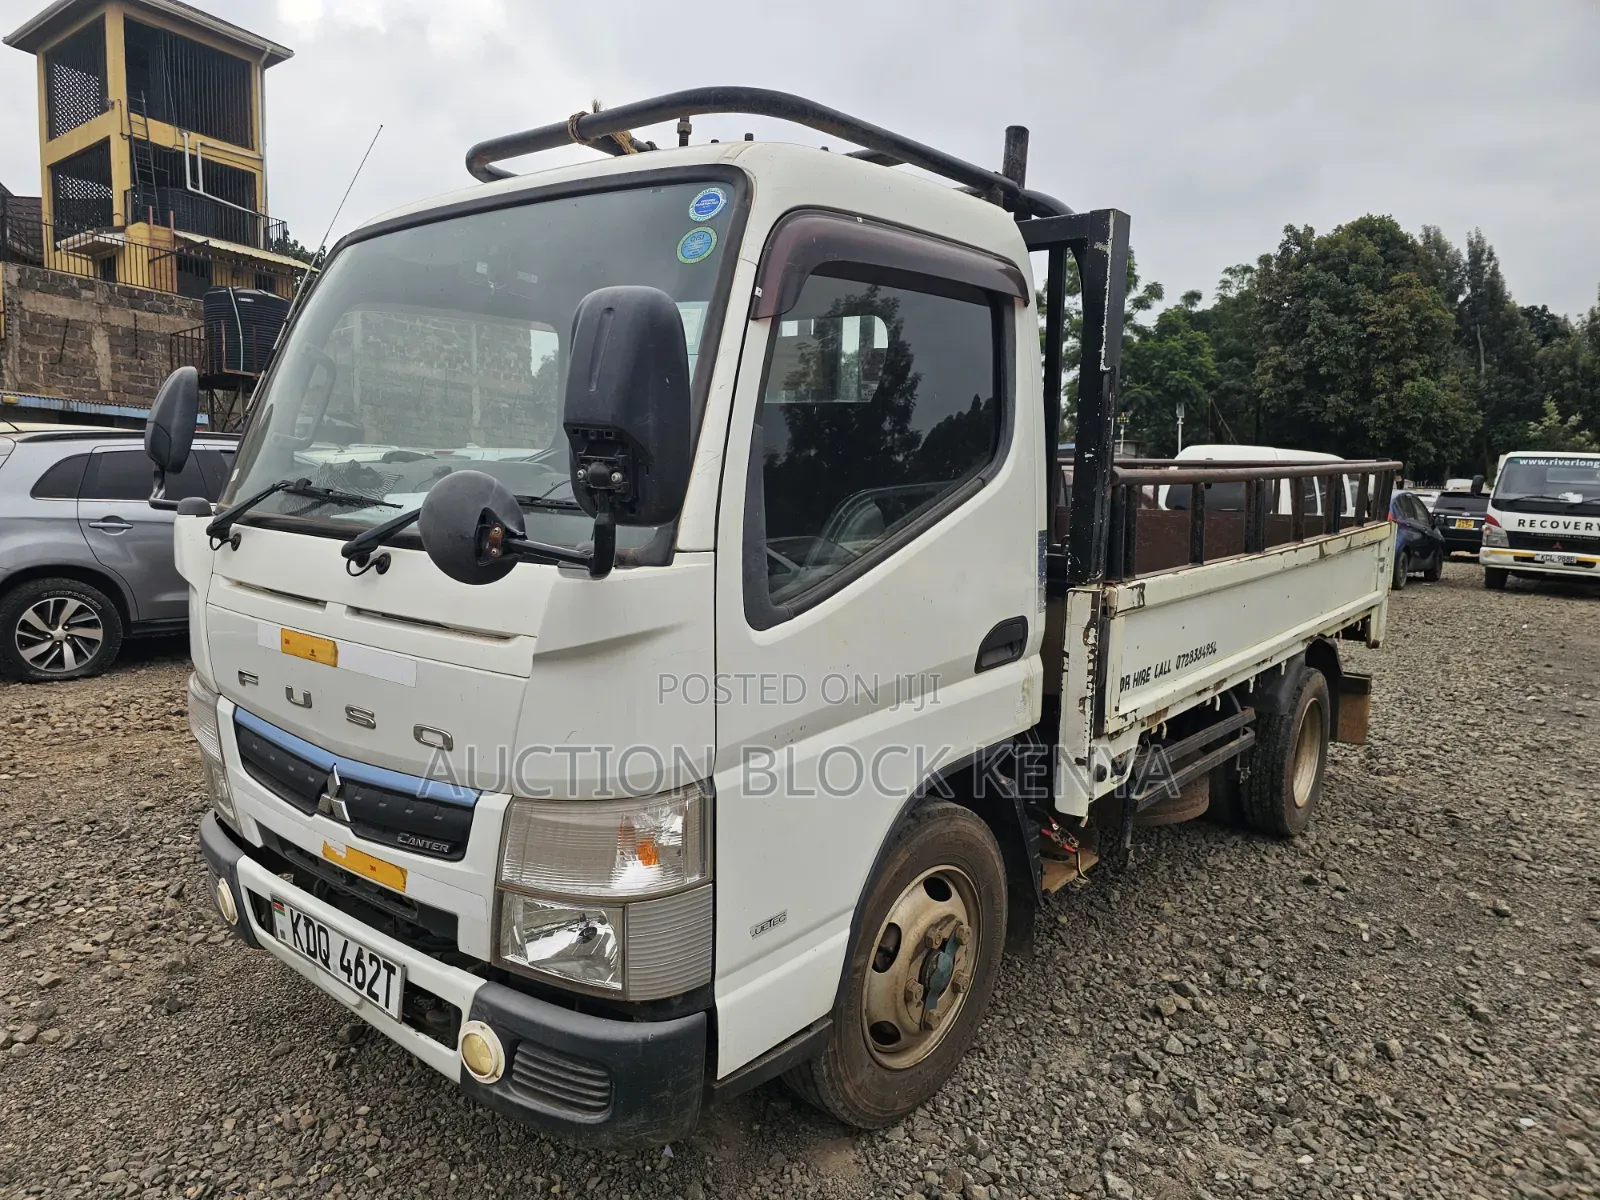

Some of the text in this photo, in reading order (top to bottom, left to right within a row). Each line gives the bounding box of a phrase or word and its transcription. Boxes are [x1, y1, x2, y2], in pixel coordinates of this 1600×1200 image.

[1132, 666, 1151, 688] HIRE
[1154, 659, 1171, 679] CALL
[237, 668, 454, 752] FUSO
[397, 832, 450, 853] CANTER
[290, 908, 396, 1010] KDQ 462T
